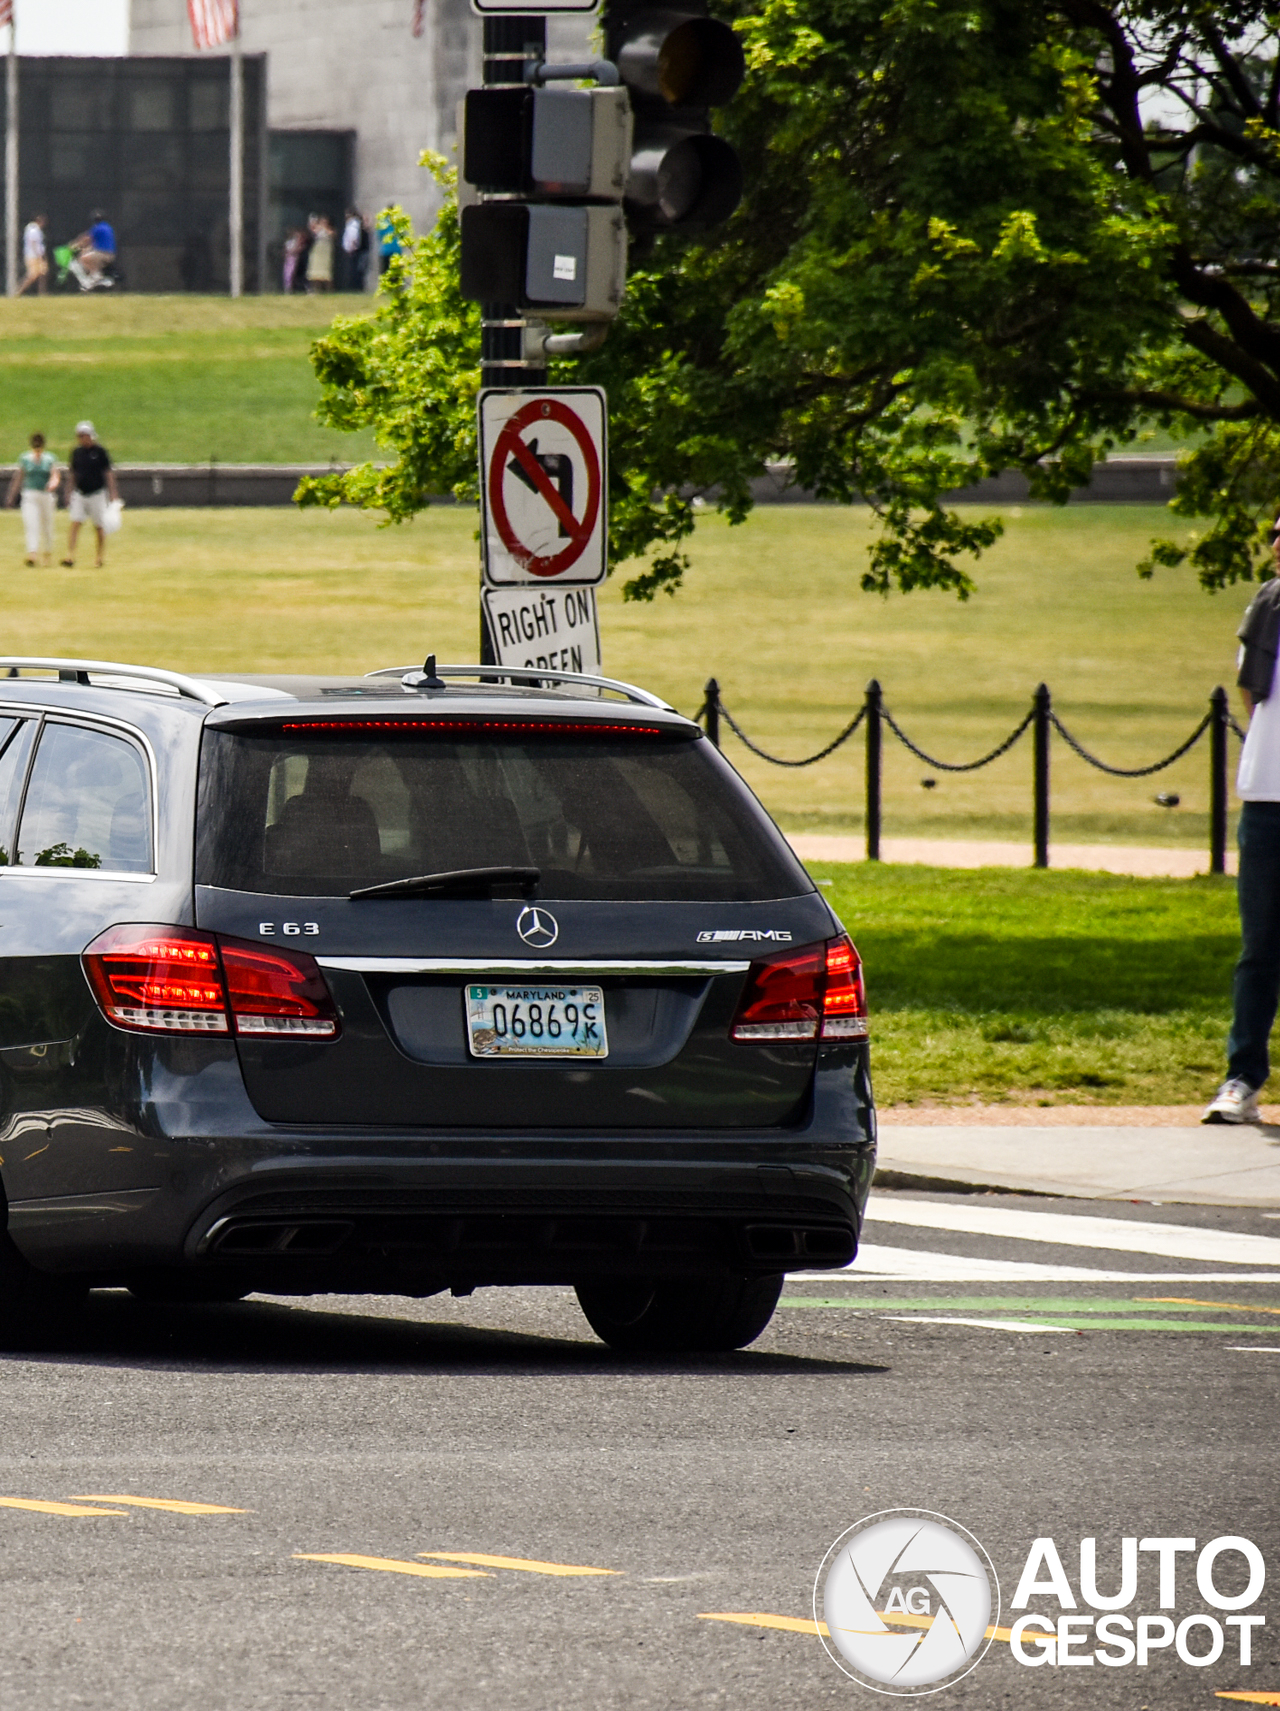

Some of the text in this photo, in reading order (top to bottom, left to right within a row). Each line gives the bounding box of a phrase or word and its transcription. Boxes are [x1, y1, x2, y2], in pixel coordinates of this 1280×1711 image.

[498, 588, 590, 647] RIGHT ON
[524, 645, 583, 688] REEN
[259, 922, 320, 935] E 63
[738, 930, 792, 941] AMG
[476, 988, 483, 998] 5
[506, 990, 566, 1000] MARYLAND
[588, 992, 600, 1002] 25
